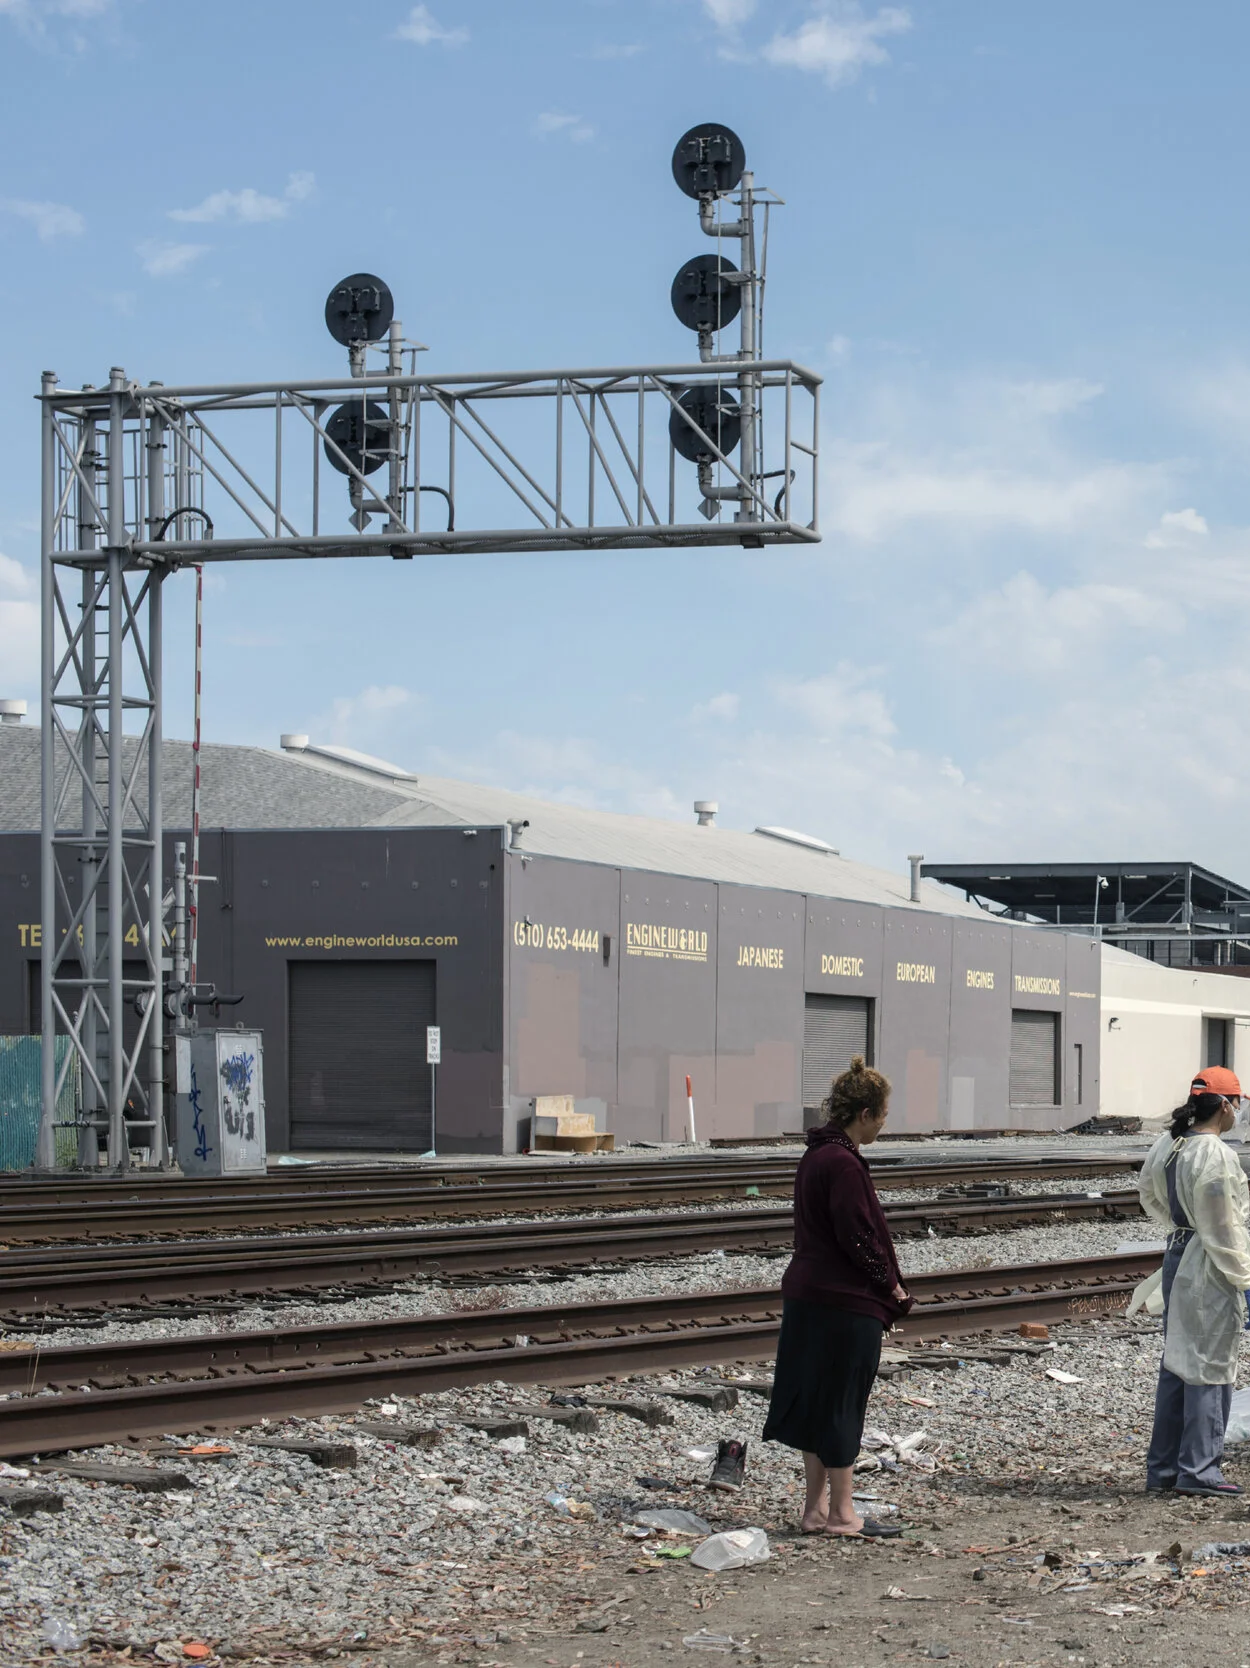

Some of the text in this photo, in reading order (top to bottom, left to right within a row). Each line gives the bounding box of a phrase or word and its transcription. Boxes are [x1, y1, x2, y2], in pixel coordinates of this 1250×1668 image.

[265, 933, 458, 949] www.engineworldusa.com
[513, 921, 599, 953] (510) 653-4444
[626, 923, 708, 953] ENGINEWORLD
[737, 946, 784, 969] JAPANESE
[821, 954, 864, 976] DOMESTIC
[896, 962, 935, 984] EUROPEAN
[966, 969, 994, 989] ENGINES
[1014, 975, 1060, 995] TRANSMISSIONS
